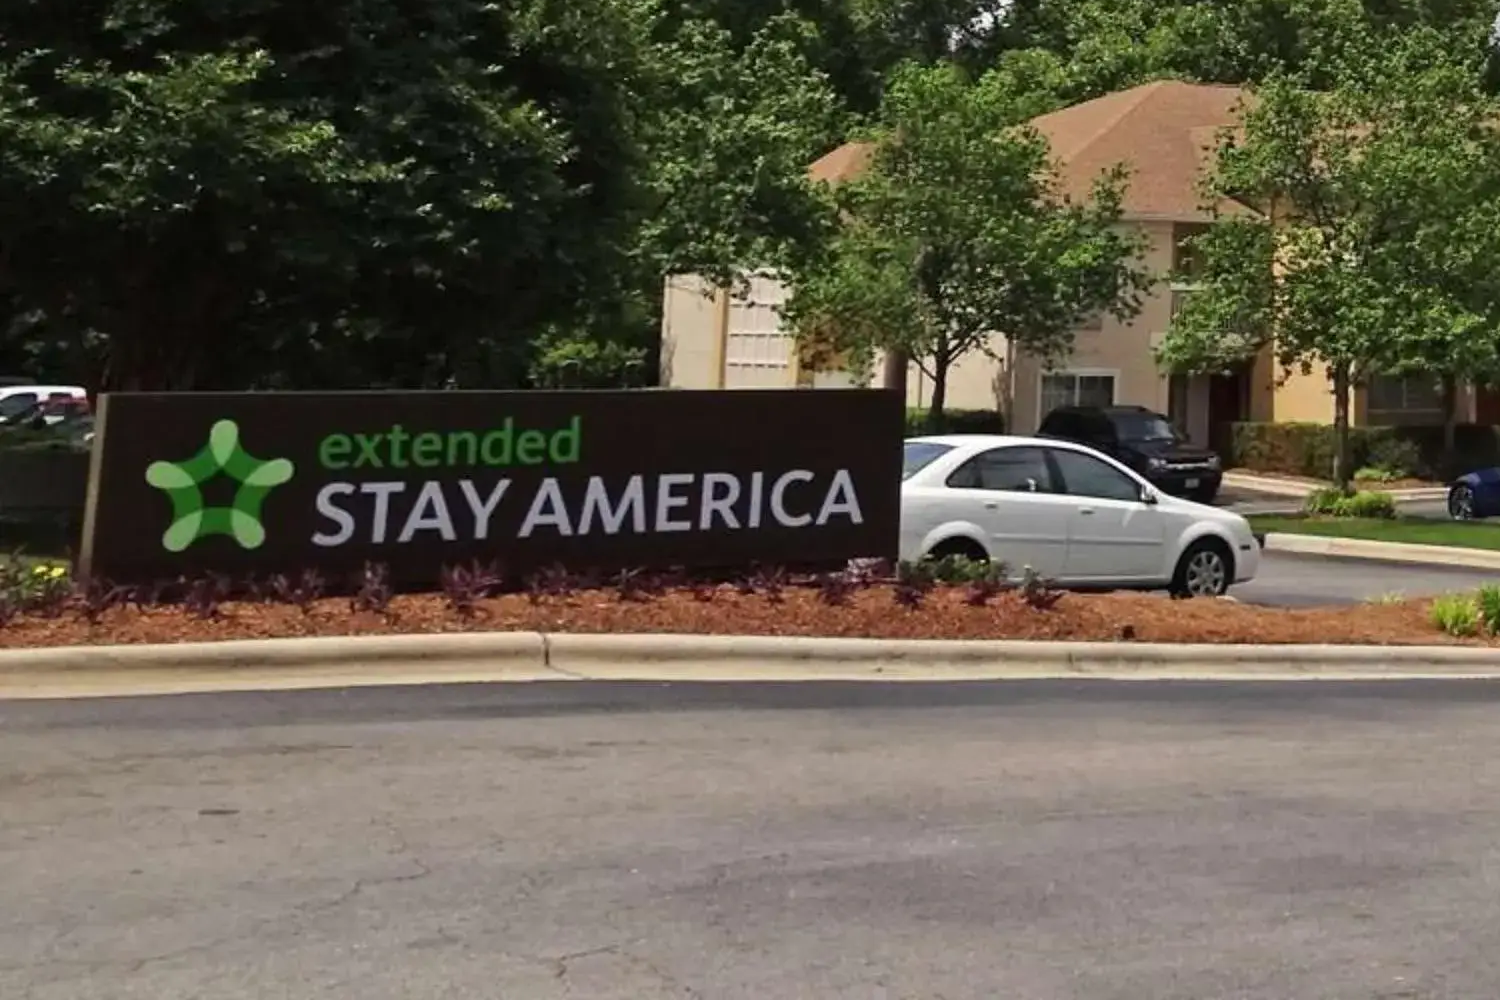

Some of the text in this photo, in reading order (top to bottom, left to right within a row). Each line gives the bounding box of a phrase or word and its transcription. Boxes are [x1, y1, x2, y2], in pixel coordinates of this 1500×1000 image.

[318, 416, 582, 470] extended
[311, 468, 864, 547] STAY AMERICA
